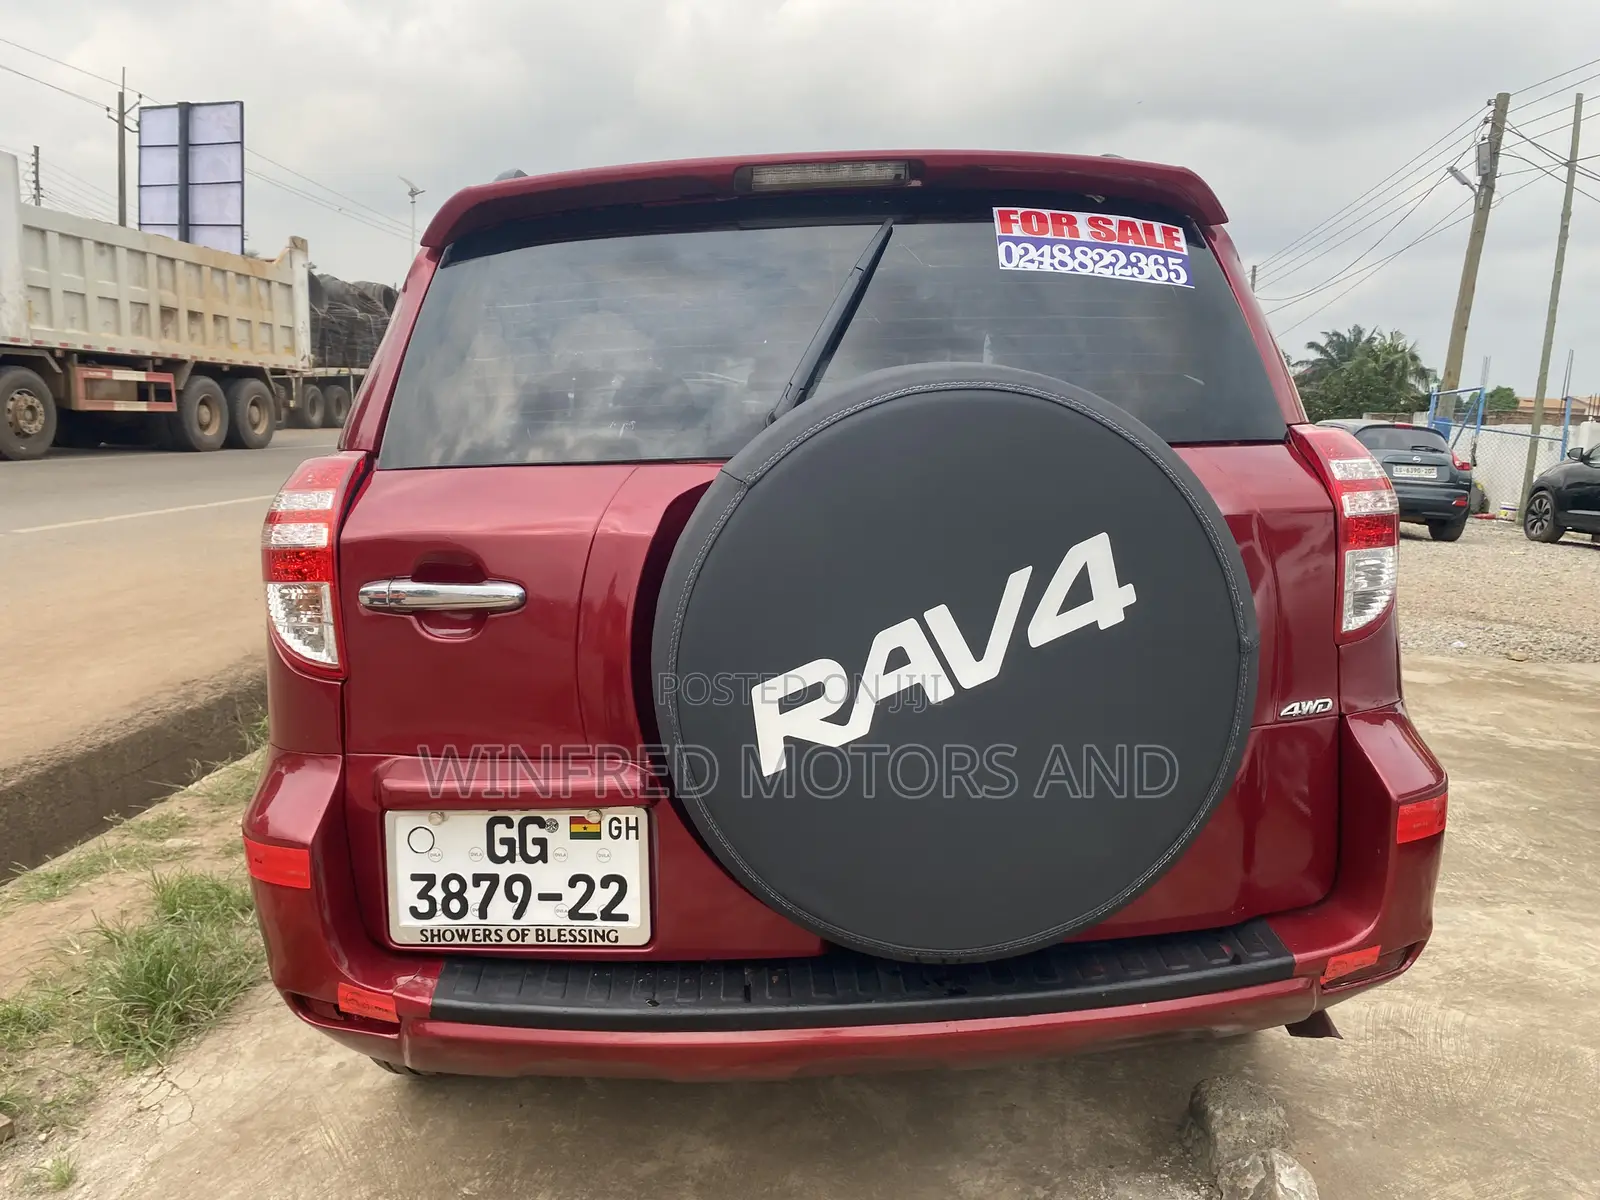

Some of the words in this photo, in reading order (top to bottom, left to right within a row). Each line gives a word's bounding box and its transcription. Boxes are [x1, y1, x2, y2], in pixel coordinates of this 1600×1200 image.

[997, 209, 1081, 239] FOR
[1086, 215, 1185, 253] SALE
[998, 241, 1188, 285] 0248822365
[751, 531, 1137, 778] RAV4
[1280, 698, 1333, 717] 4WD
[486, 815, 548, 865] GG
[607, 816, 639, 841] GH
[409, 873, 630, 921] 3879-22
[420, 928, 504, 943] SHOWERS
[506, 928, 531, 943] OF
[535, 928, 619, 944] BLESSING
